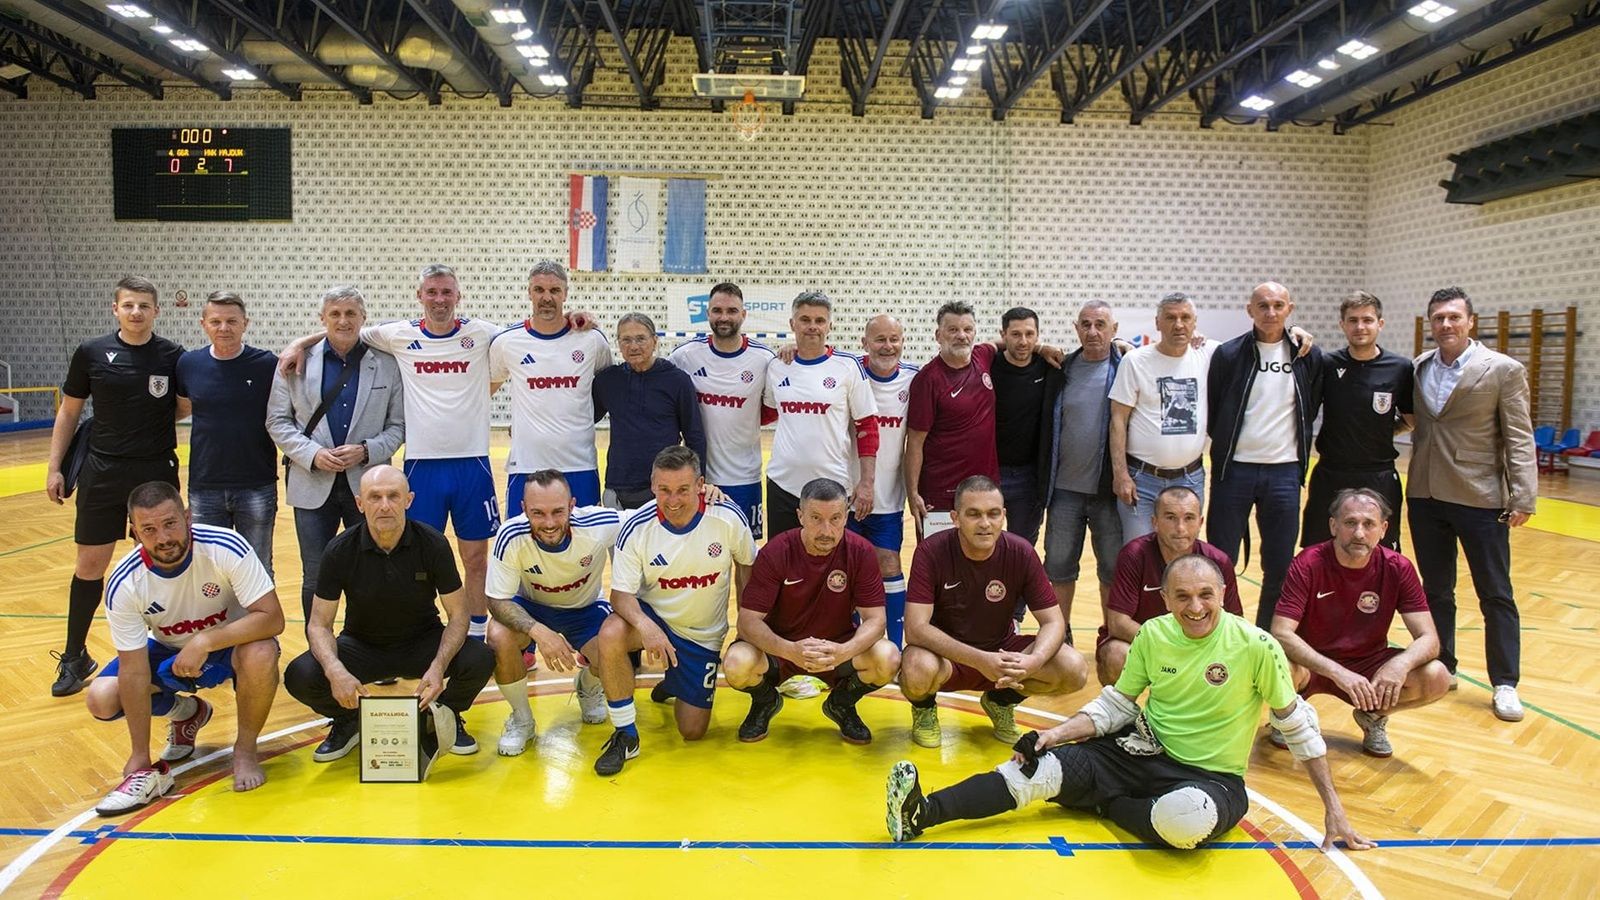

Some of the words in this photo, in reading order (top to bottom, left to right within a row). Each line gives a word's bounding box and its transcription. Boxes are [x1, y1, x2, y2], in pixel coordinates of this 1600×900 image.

[171, 159, 180, 173] 0
[197, 158, 206, 170] 2
[224, 159, 232, 172] 7
[744, 302, 786, 311] SPORT
[414, 361, 470, 374] TOMMY
[1259, 361, 1292, 373] UGO
[527, 376, 580, 390] TOMMY
[695, 391, 747, 409] TOMMY
[780, 401, 832, 414] TOMMY
[876, 415, 904, 428] MMY
[483, 496, 499, 521] 10
[751, 503, 763, 526] 18
[531, 572, 592, 594] TOMMY
[658, 571, 721, 590] TOMMY
[158, 607, 228, 636] TOMMY
[1160, 666, 1177, 674] JAKO
